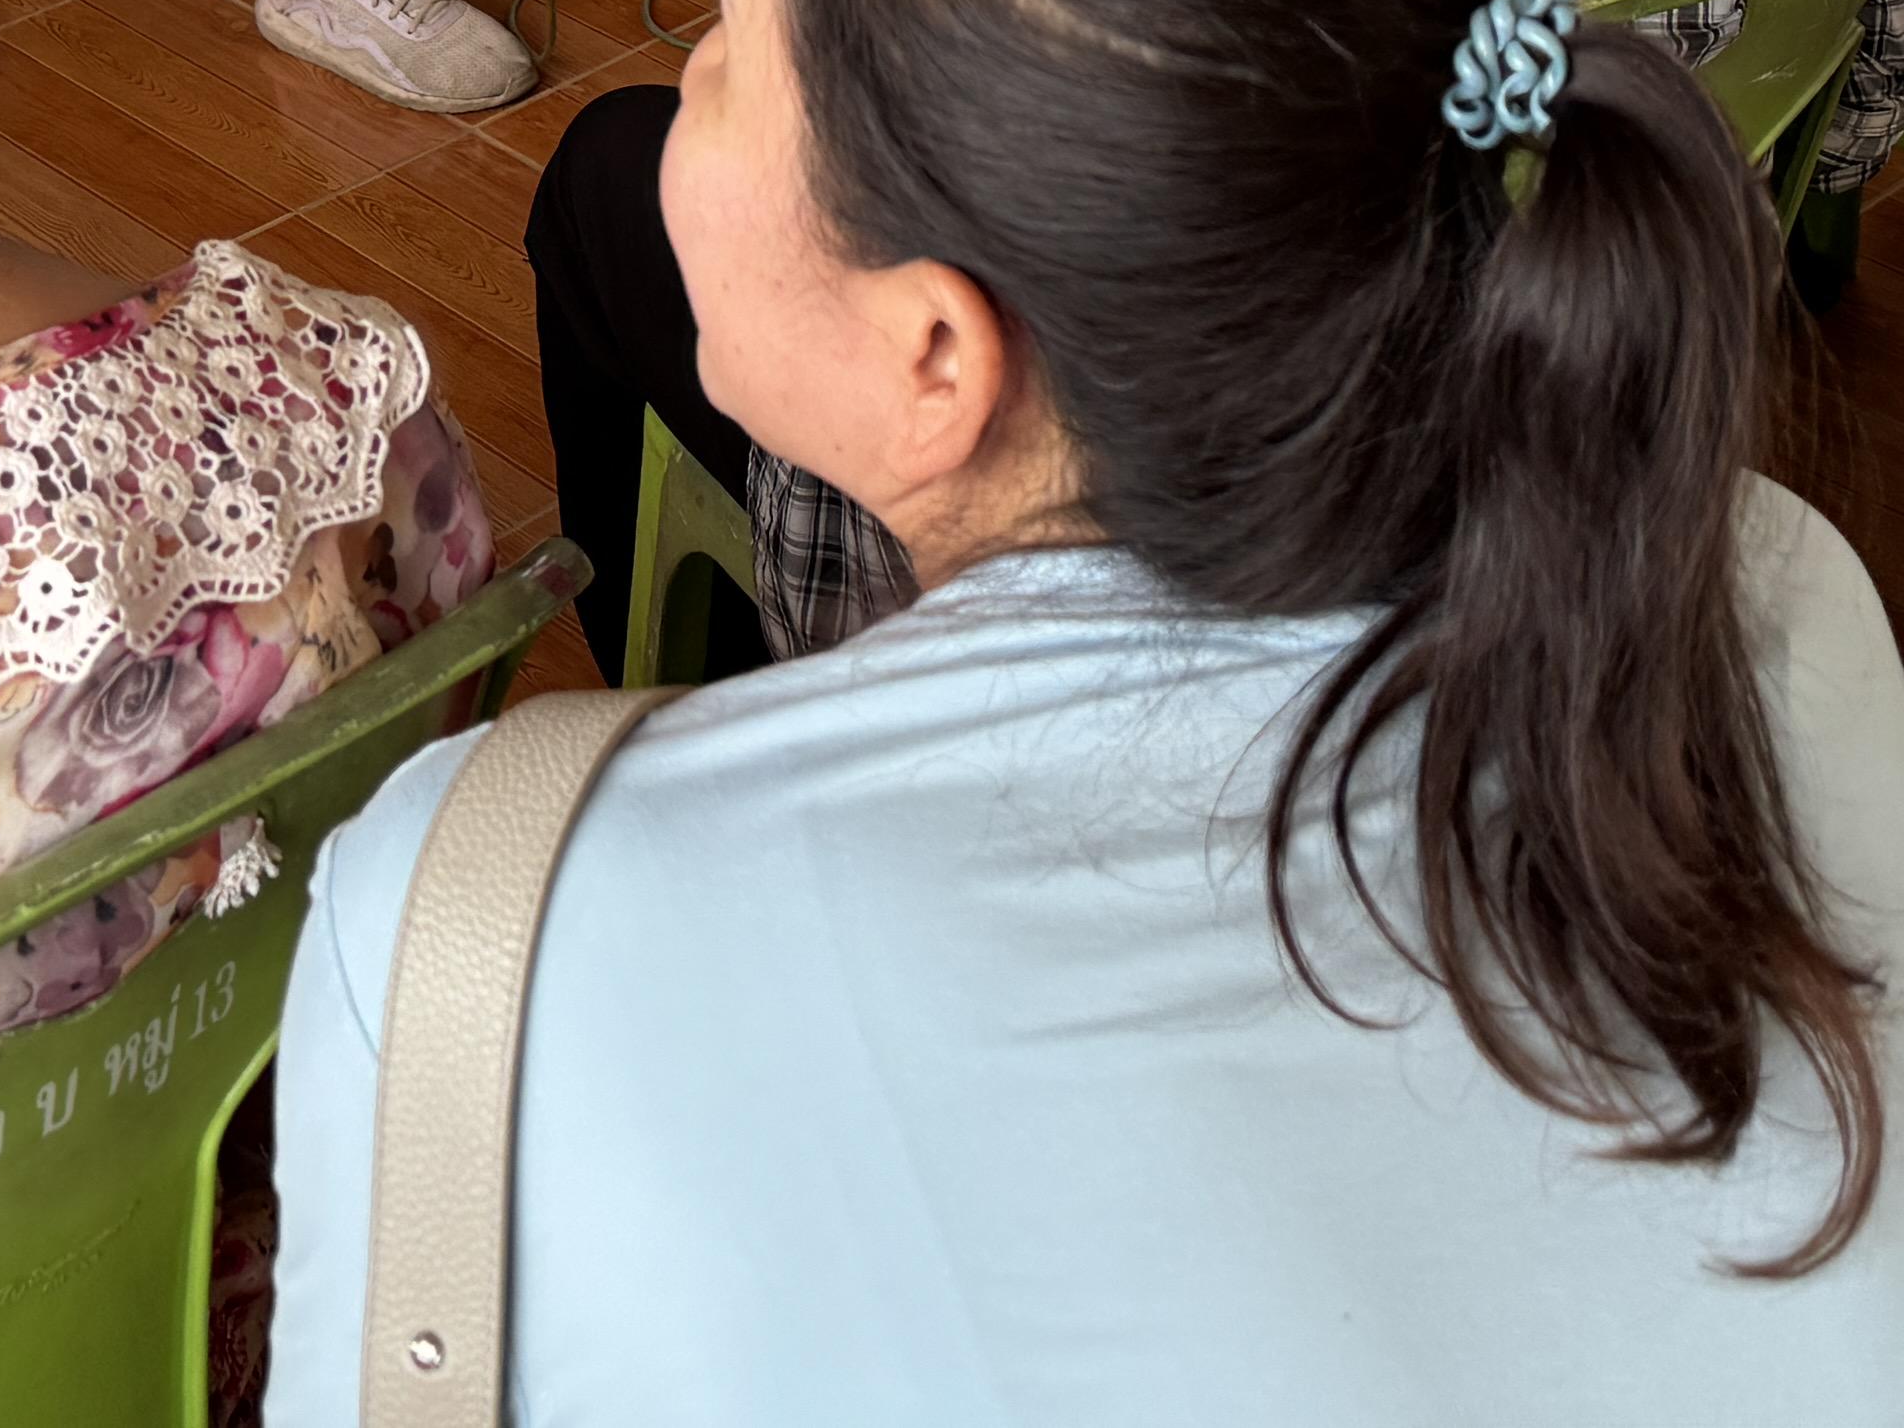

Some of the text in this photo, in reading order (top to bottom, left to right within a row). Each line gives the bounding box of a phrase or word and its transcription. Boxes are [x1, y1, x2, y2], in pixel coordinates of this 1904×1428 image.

[36, 1067, 79, 1138] บ
[103, 983, 182, 1096] หมู่
[188, 960, 237, 1040] 13
